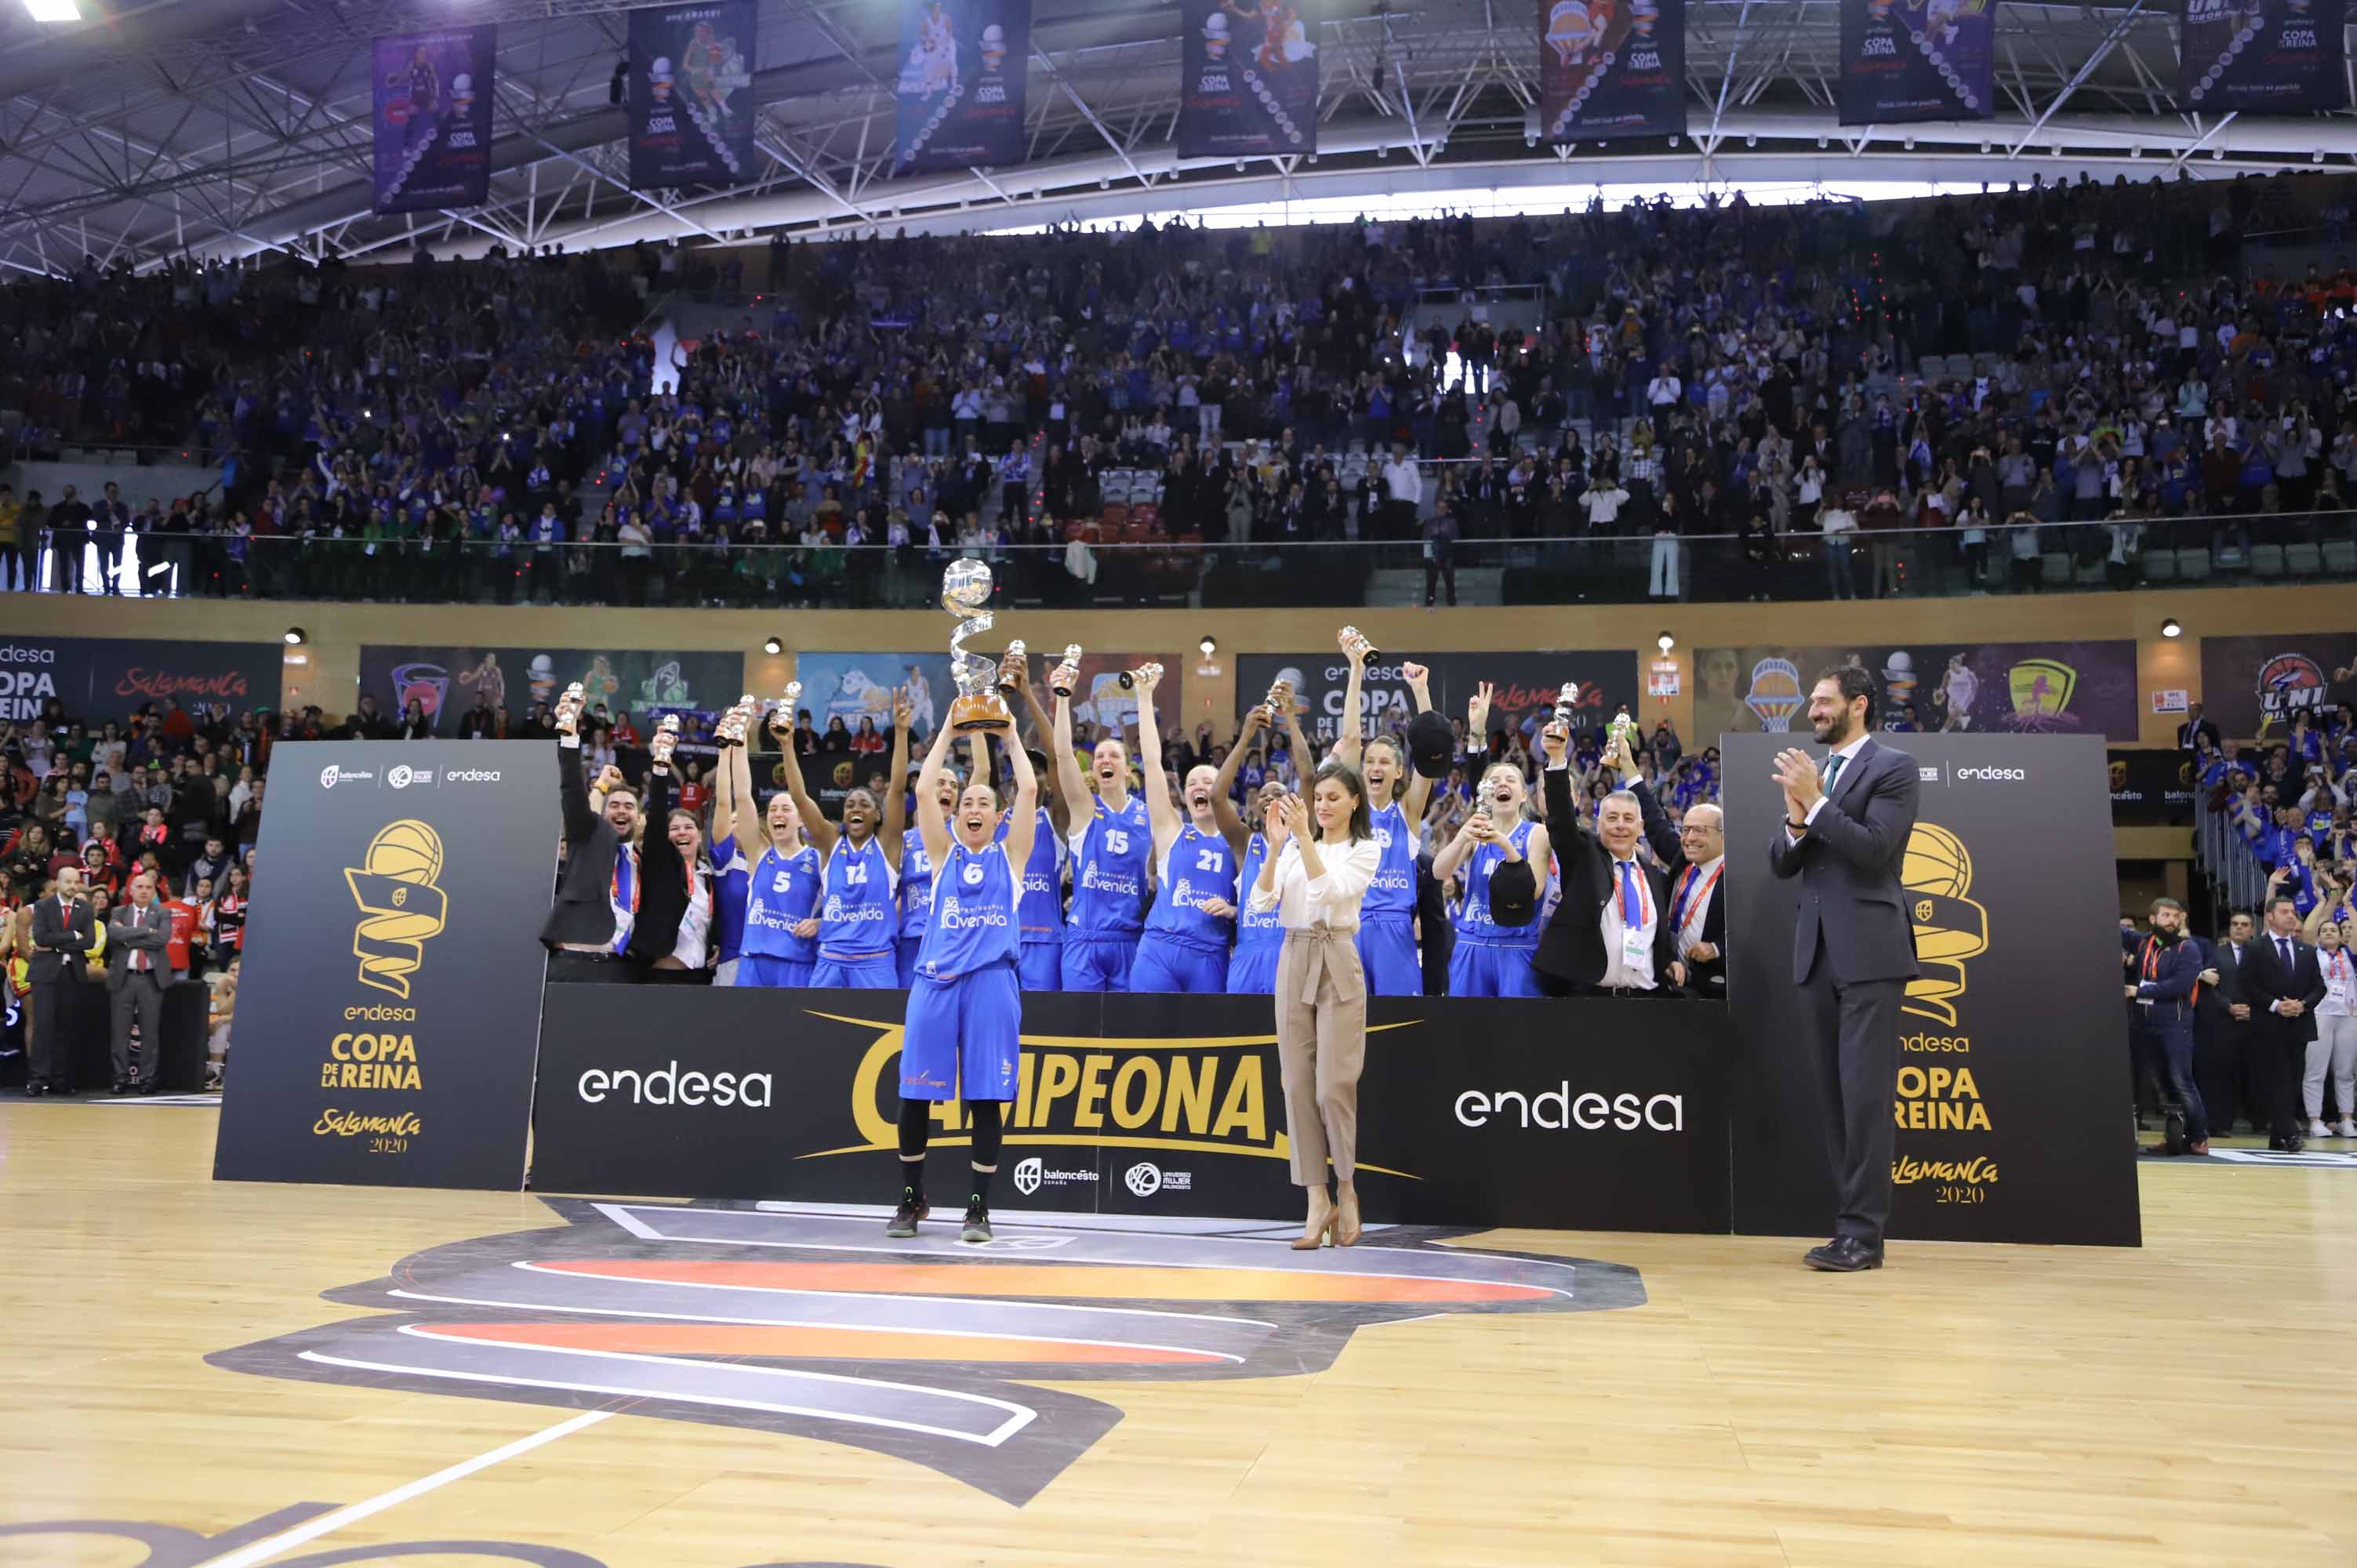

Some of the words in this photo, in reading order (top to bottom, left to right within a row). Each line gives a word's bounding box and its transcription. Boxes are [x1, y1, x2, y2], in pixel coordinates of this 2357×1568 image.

[1325, 665, 1404, 681] enesa
[0, 698, 43, 720] EIN
[1317, 717, 1333, 728] DE
[447, 768, 501, 782] endesa
[1957, 765, 2025, 780] endesa
[2109, 789, 2142, 800] ncesto
[1105, 829, 1129, 855] 15
[913, 851, 932, 873] 13
[1196, 848, 1224, 873] 21
[772, 870, 791, 894] 5
[845, 862, 868, 885] 12
[963, 862, 984, 885] 6
[1022, 877, 1050, 893] nida
[343, 1003, 416, 1022] endesa
[331, 1033, 417, 1062] COPA
[1899, 1032, 1970, 1053] ndesa
[322, 1062, 339, 1075] DE
[340, 1062, 422, 1090] REINA
[321, 1075, 339, 1087] LA
[578, 1060, 772, 1107] endesa
[1896, 1066, 1980, 1099] OPA
[1455, 1080, 1683, 1131] endesa
[369, 1138, 408, 1153] 2020
[1044, 1169, 1099, 1181] baloncesto
[1936, 1185, 1985, 1204] 2020
